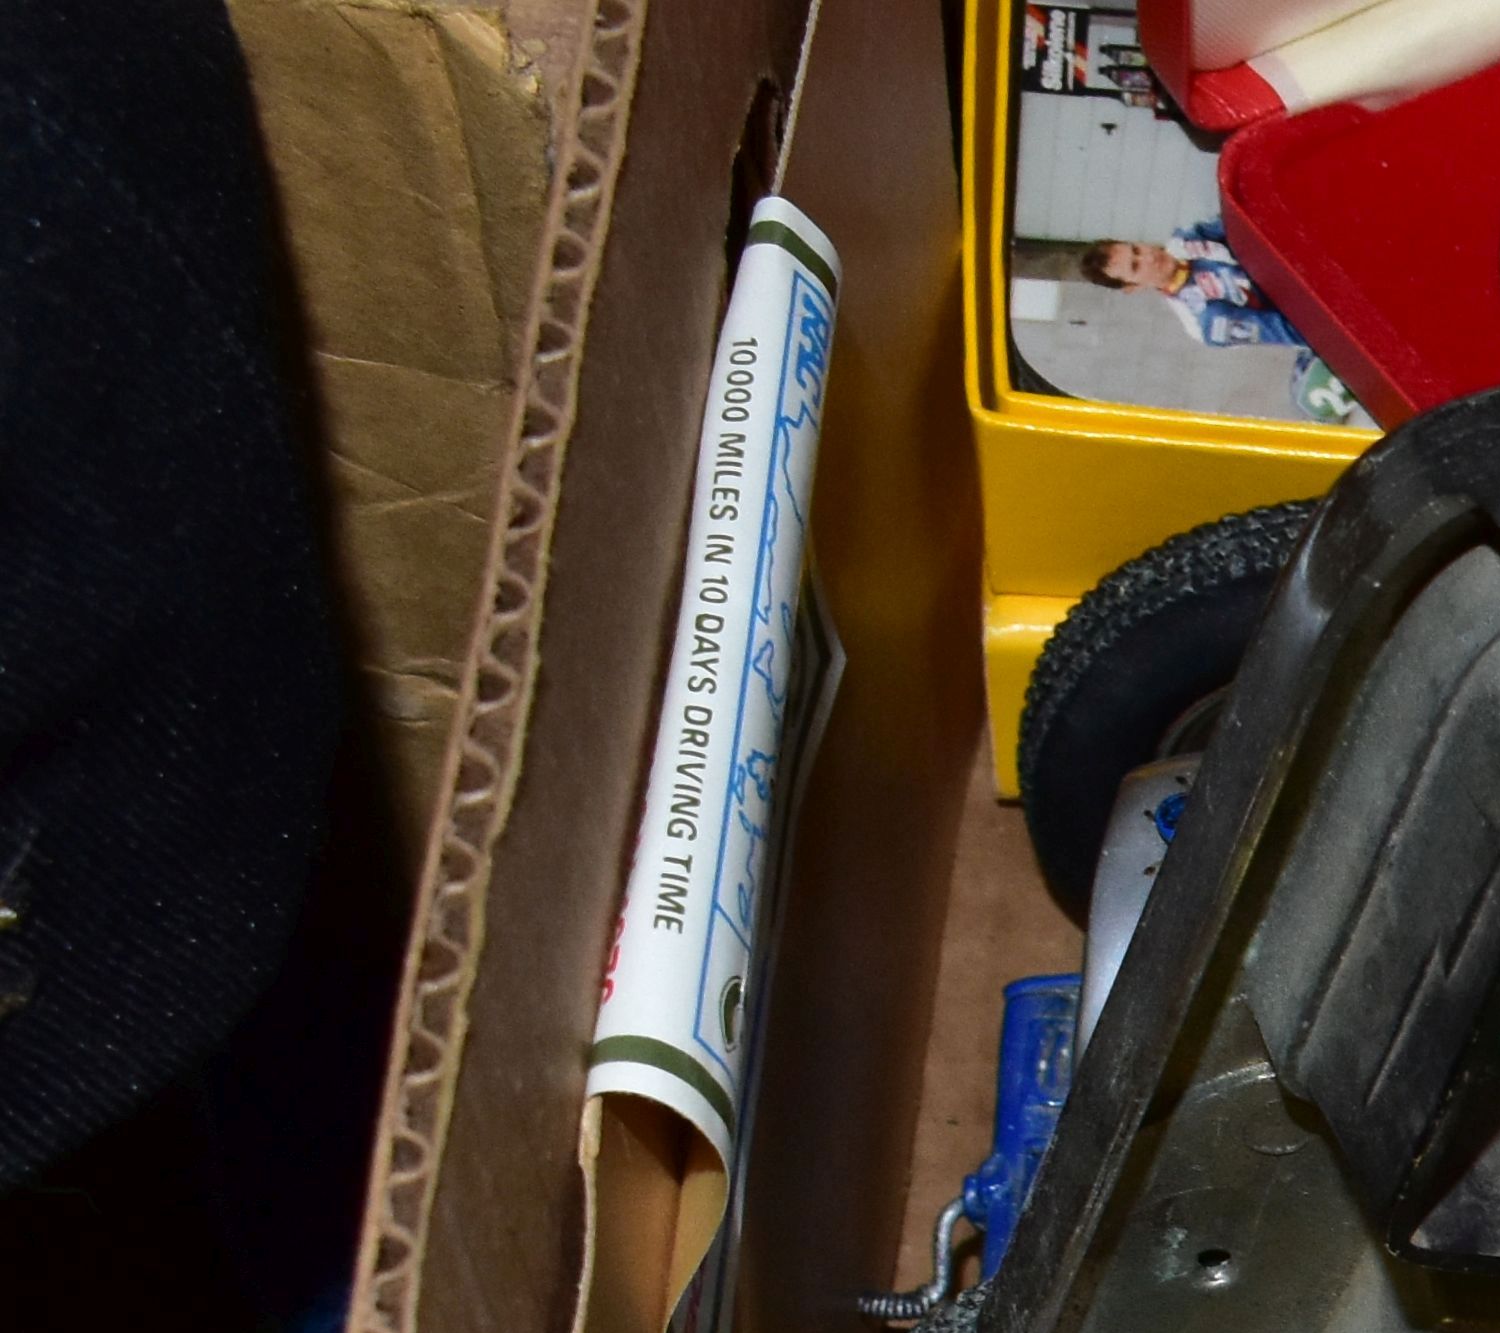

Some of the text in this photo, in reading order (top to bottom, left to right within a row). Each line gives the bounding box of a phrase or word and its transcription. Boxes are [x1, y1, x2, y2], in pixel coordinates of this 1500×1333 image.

[654, 336, 759, 935] 10000 MILES IN 10 DAYS DRIVING TIME
